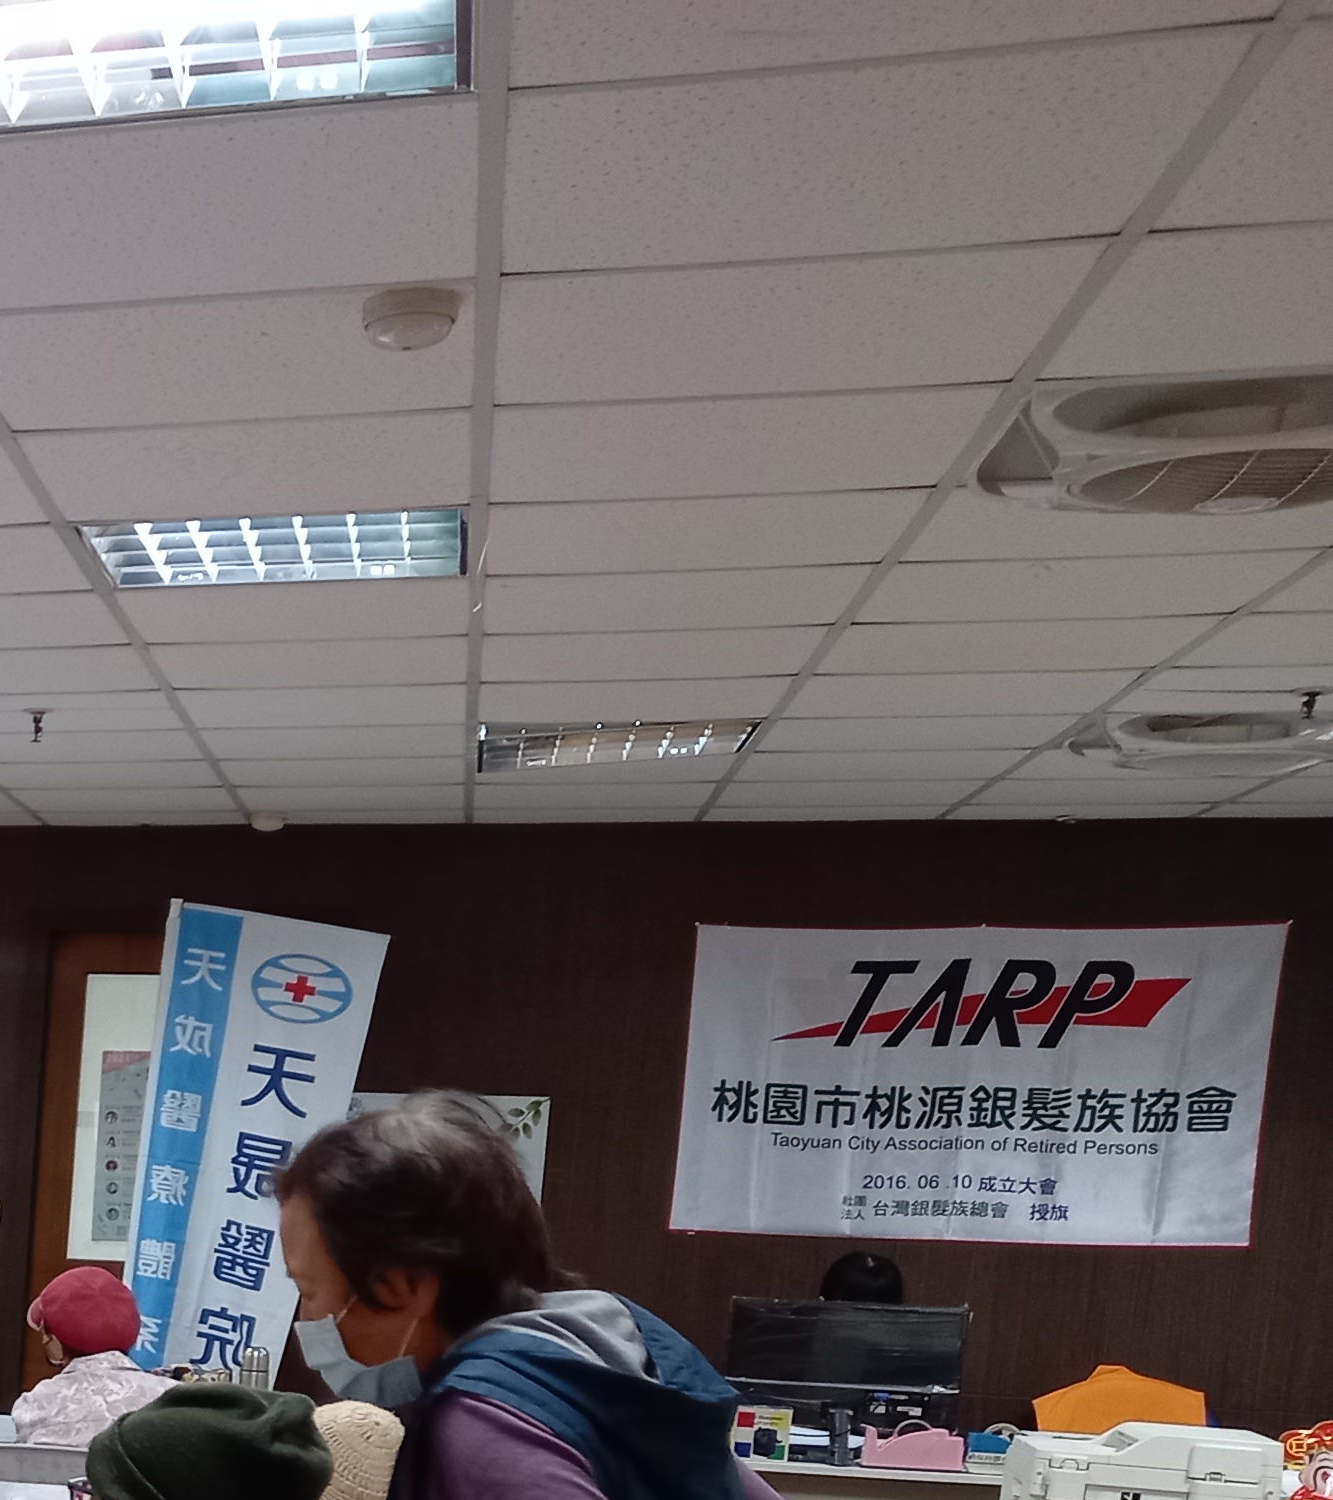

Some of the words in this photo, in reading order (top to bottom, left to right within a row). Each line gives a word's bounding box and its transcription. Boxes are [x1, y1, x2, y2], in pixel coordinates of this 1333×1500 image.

[833, 958, 1136, 1048] TARP
[711, 1078, 1238, 1134] 桃園市桃源銀髮族協會
[770, 1132, 843, 1152] Taoyuan
[848, 1135, 881, 1154] City
[883, 1135, 985, 1151] Association
[990, 1137, 1010, 1152] of
[1013, 1137, 1078, 1154] Retired
[1083, 1139, 1159, 1156] Persons
[977, 1176, 1059, 1196] 成立大會
[1029, 1203, 1069, 1222] 授旗
